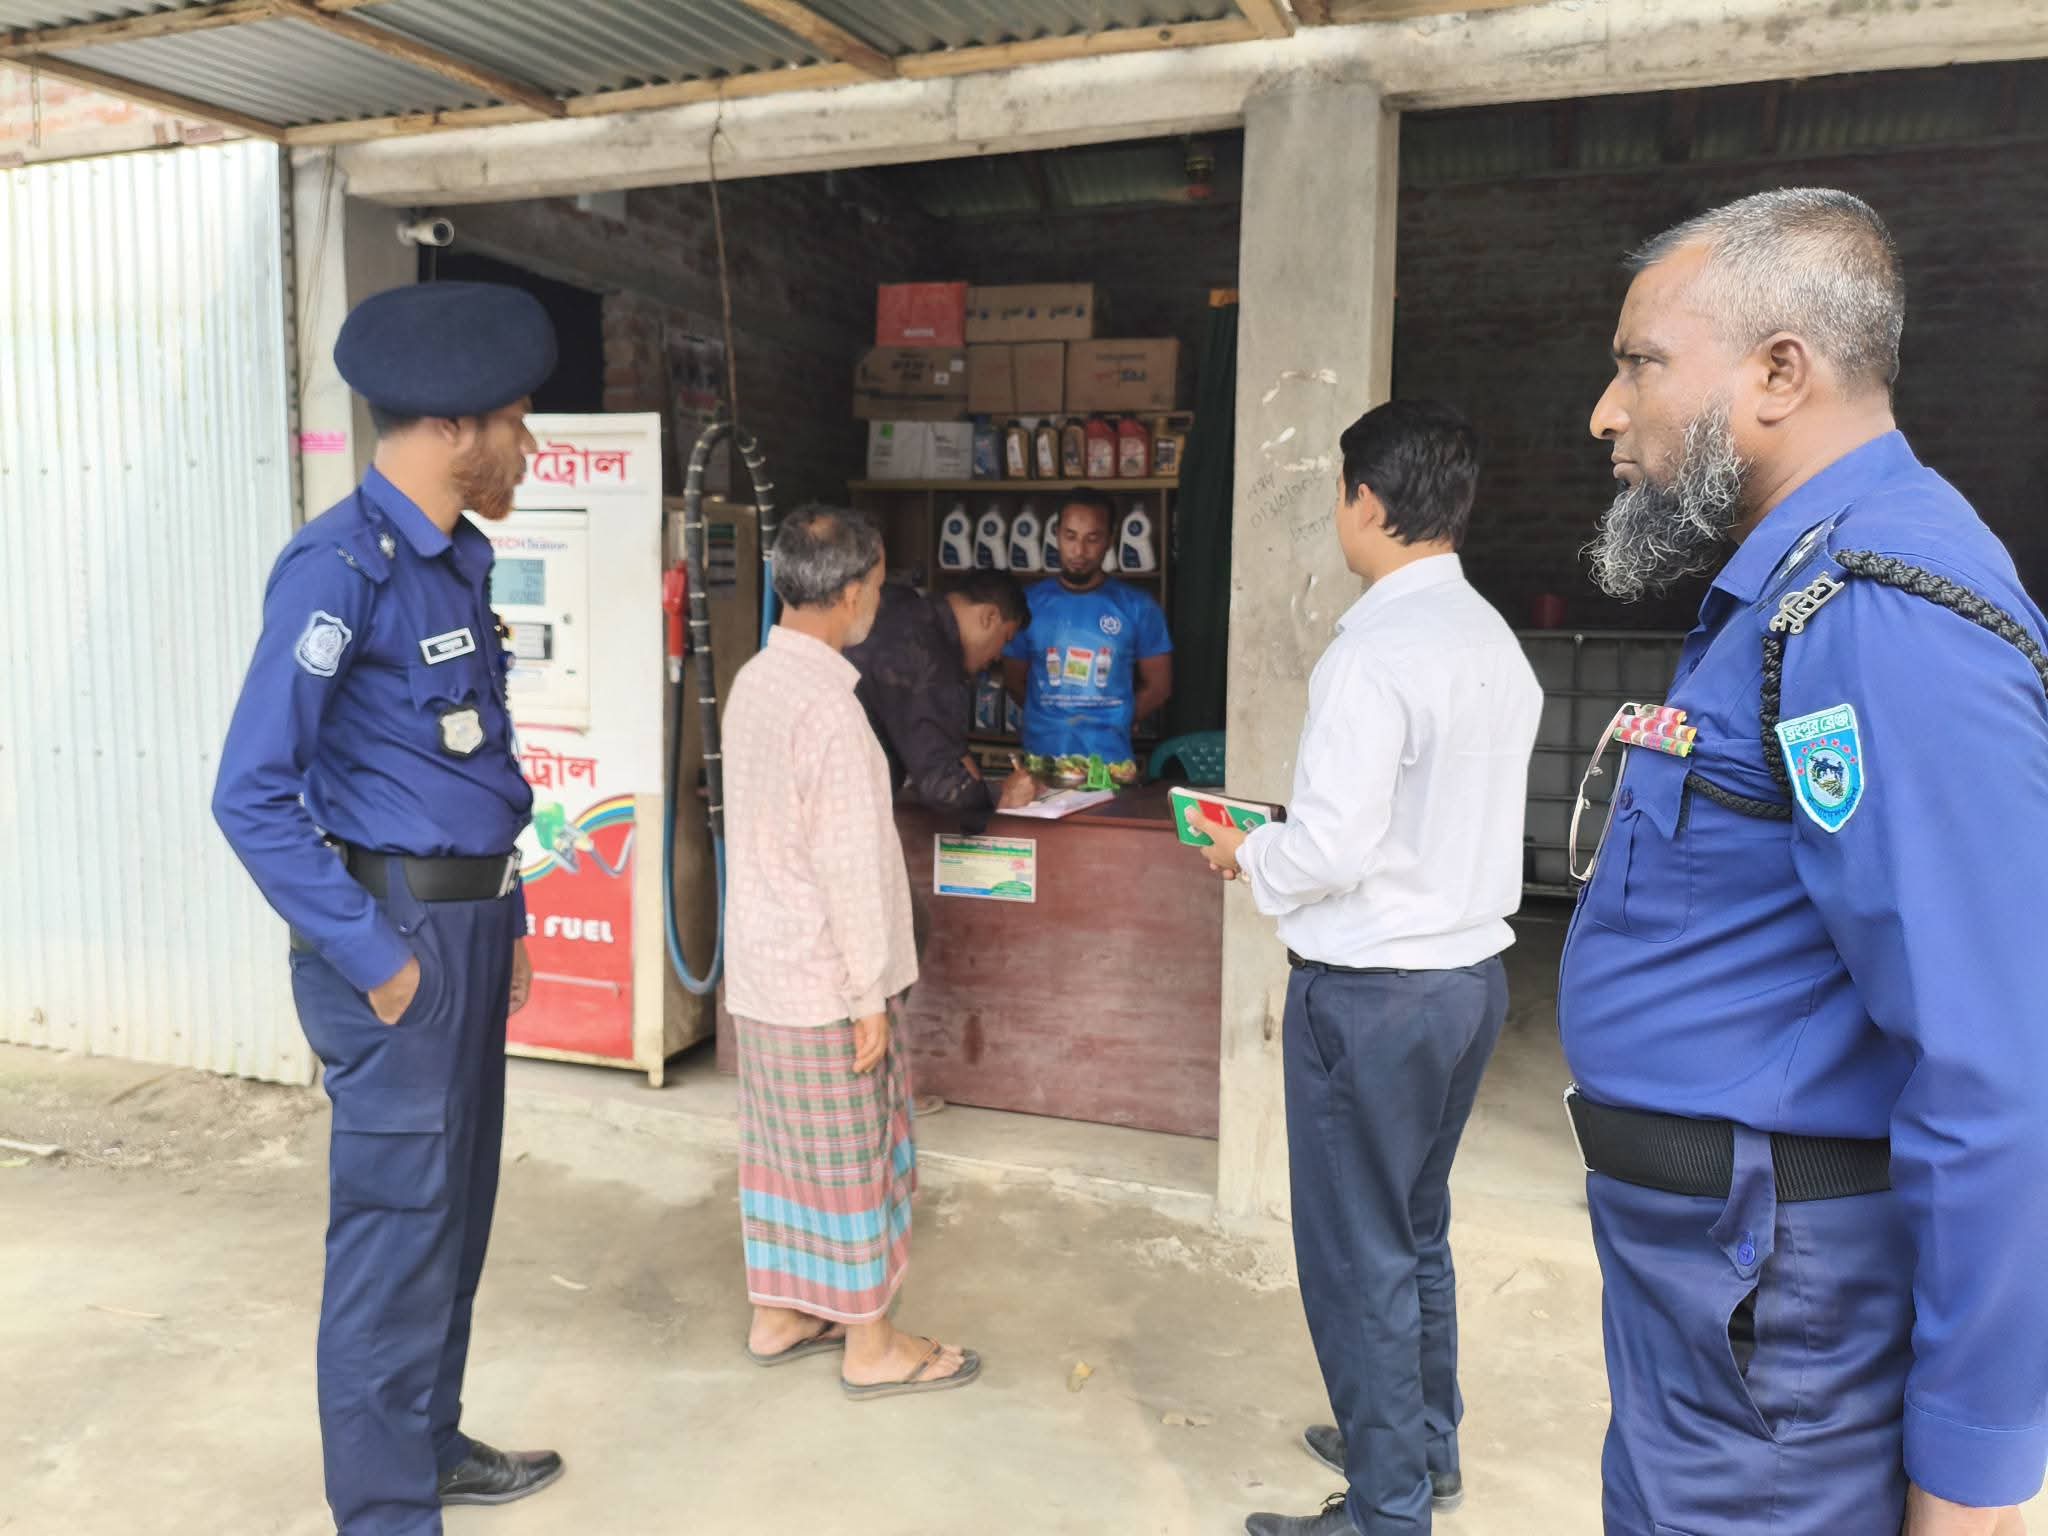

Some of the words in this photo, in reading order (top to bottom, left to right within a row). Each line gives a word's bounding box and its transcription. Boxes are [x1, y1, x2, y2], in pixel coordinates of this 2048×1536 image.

[531, 440, 632, 488] ট্রোল
[1768, 570, 1845, 634] পুলিশ
[1784, 719, 1819, 742] রংপুর
[519, 743, 599, 789] ট্রোল
[544, 914, 615, 944] FUEL
